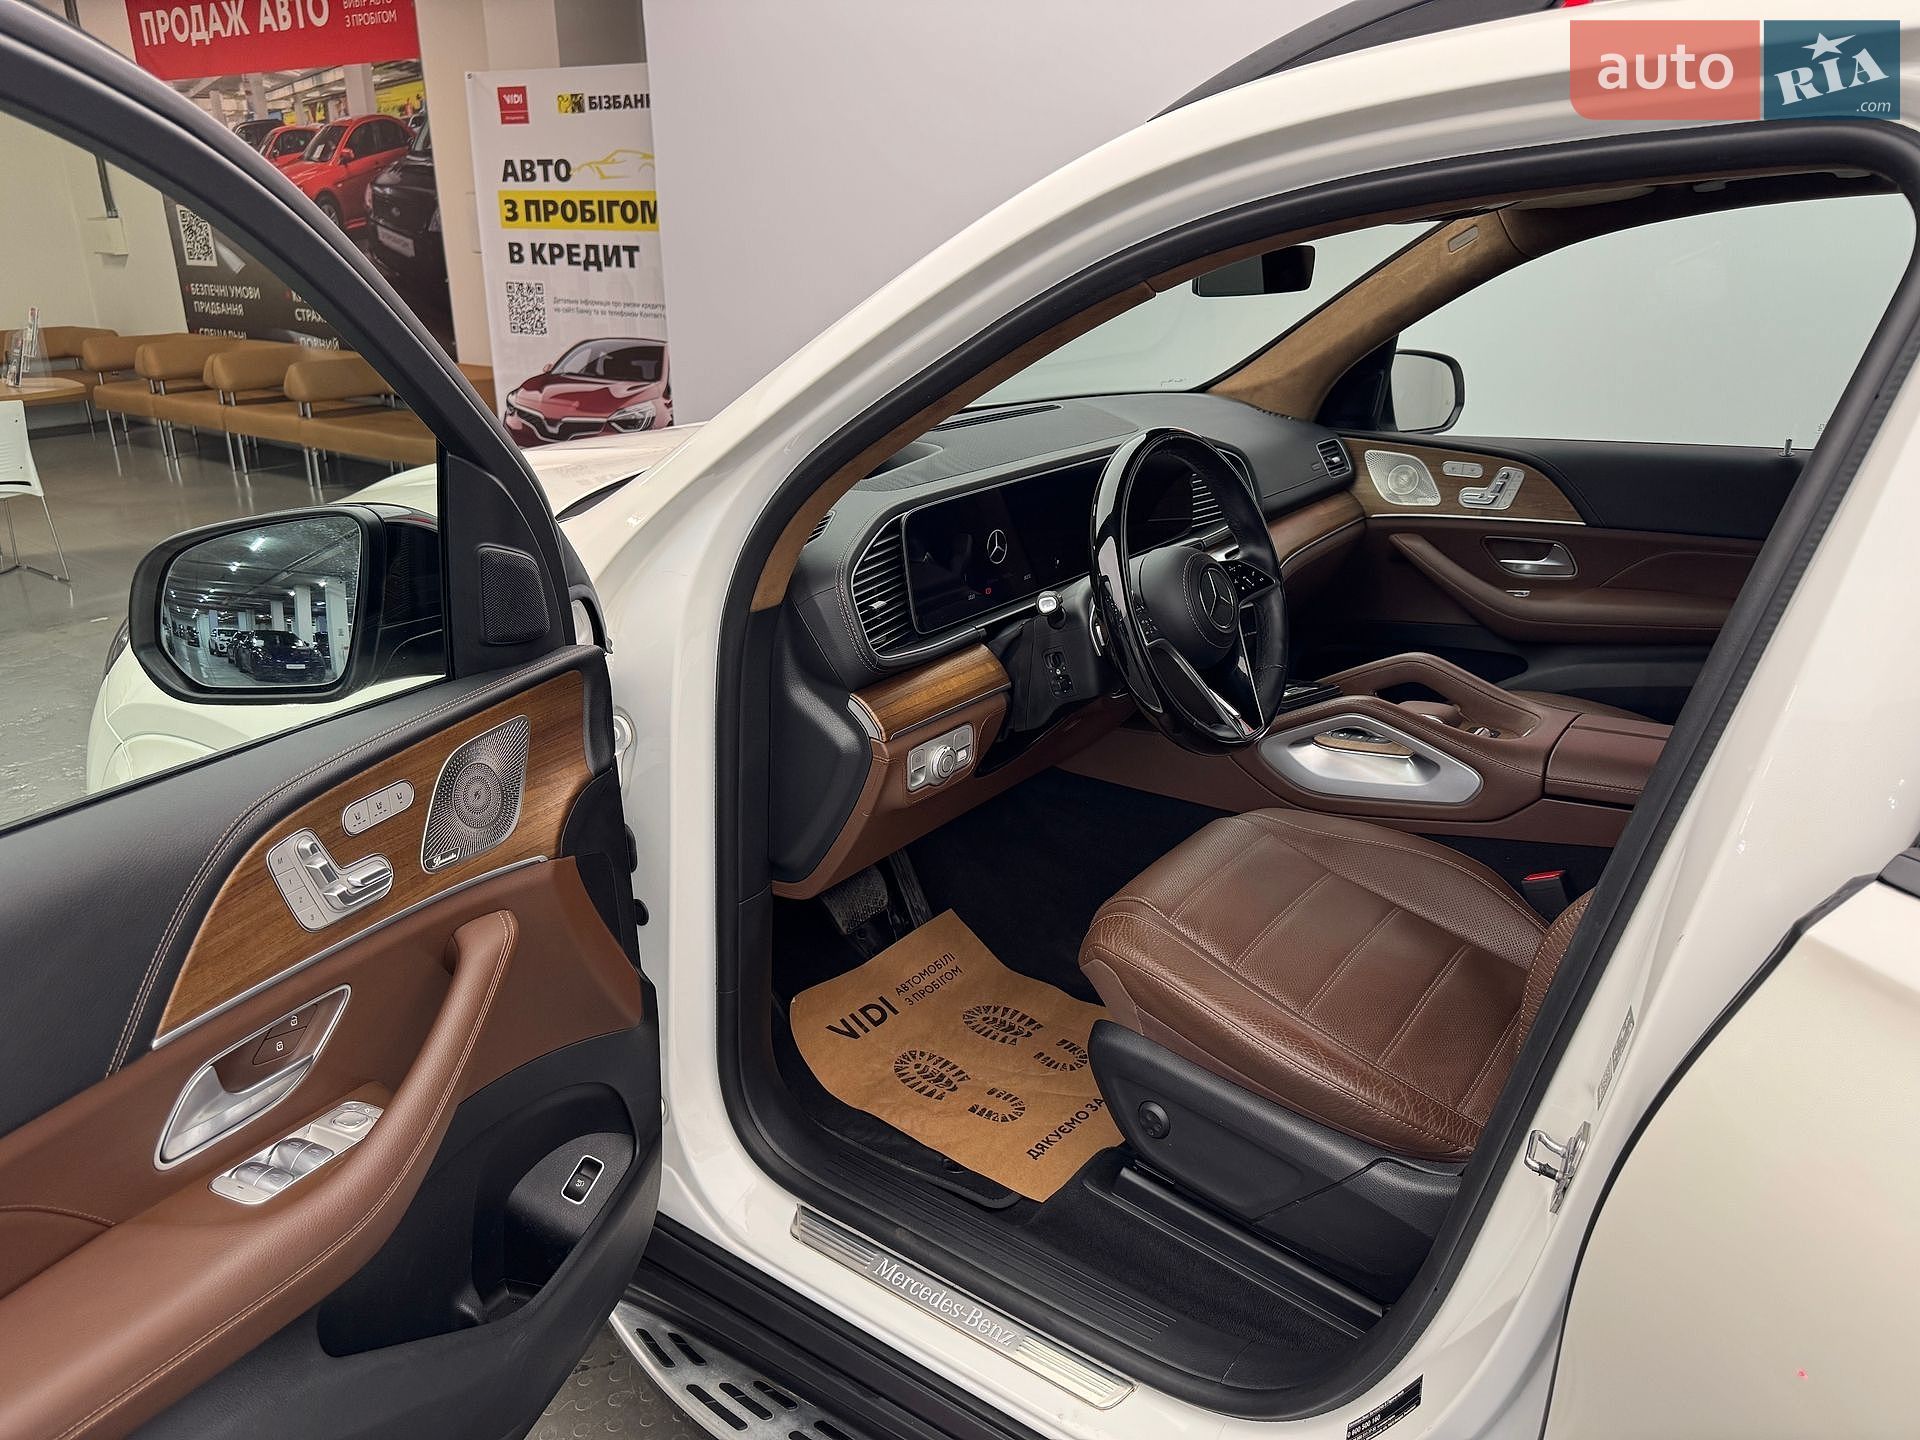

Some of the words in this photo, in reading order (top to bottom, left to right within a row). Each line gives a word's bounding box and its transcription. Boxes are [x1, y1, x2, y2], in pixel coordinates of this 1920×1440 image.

[139, 0, 250, 46] ПРОДАЖ
[259, 0, 330, 33] АВТО
[344, 15, 351, 28] З
[351, 9, 398, 27] ПРОБІГОМ
[502, 93, 523, 105] VIDI
[502, 158, 572, 183] АВТО
[503, 199, 519, 222] З
[524, 199, 658, 225] ПРОБІГОМ
[508, 242, 525, 264] В
[530, 242, 640, 272] КРЕДИТ
[190, 283, 228, 298] БЕЗПЕЧНІ
[230, 285, 261, 300] УМОВИ
[193, 301, 244, 316] ПРИДБАННЯ
[895, 952, 956, 997] АВТОМОБІЛІ
[904, 996, 915, 1007] З
[913, 965, 963, 1003] ПРОБІГОМ
[825, 996, 900, 1040] VIDI
[1026, 1109, 1090, 1160] ДЯКУЄМО
[1084, 1096, 1105, 1113] ЗА
[873, 1257, 1017, 1347] Mercedes-Benz
